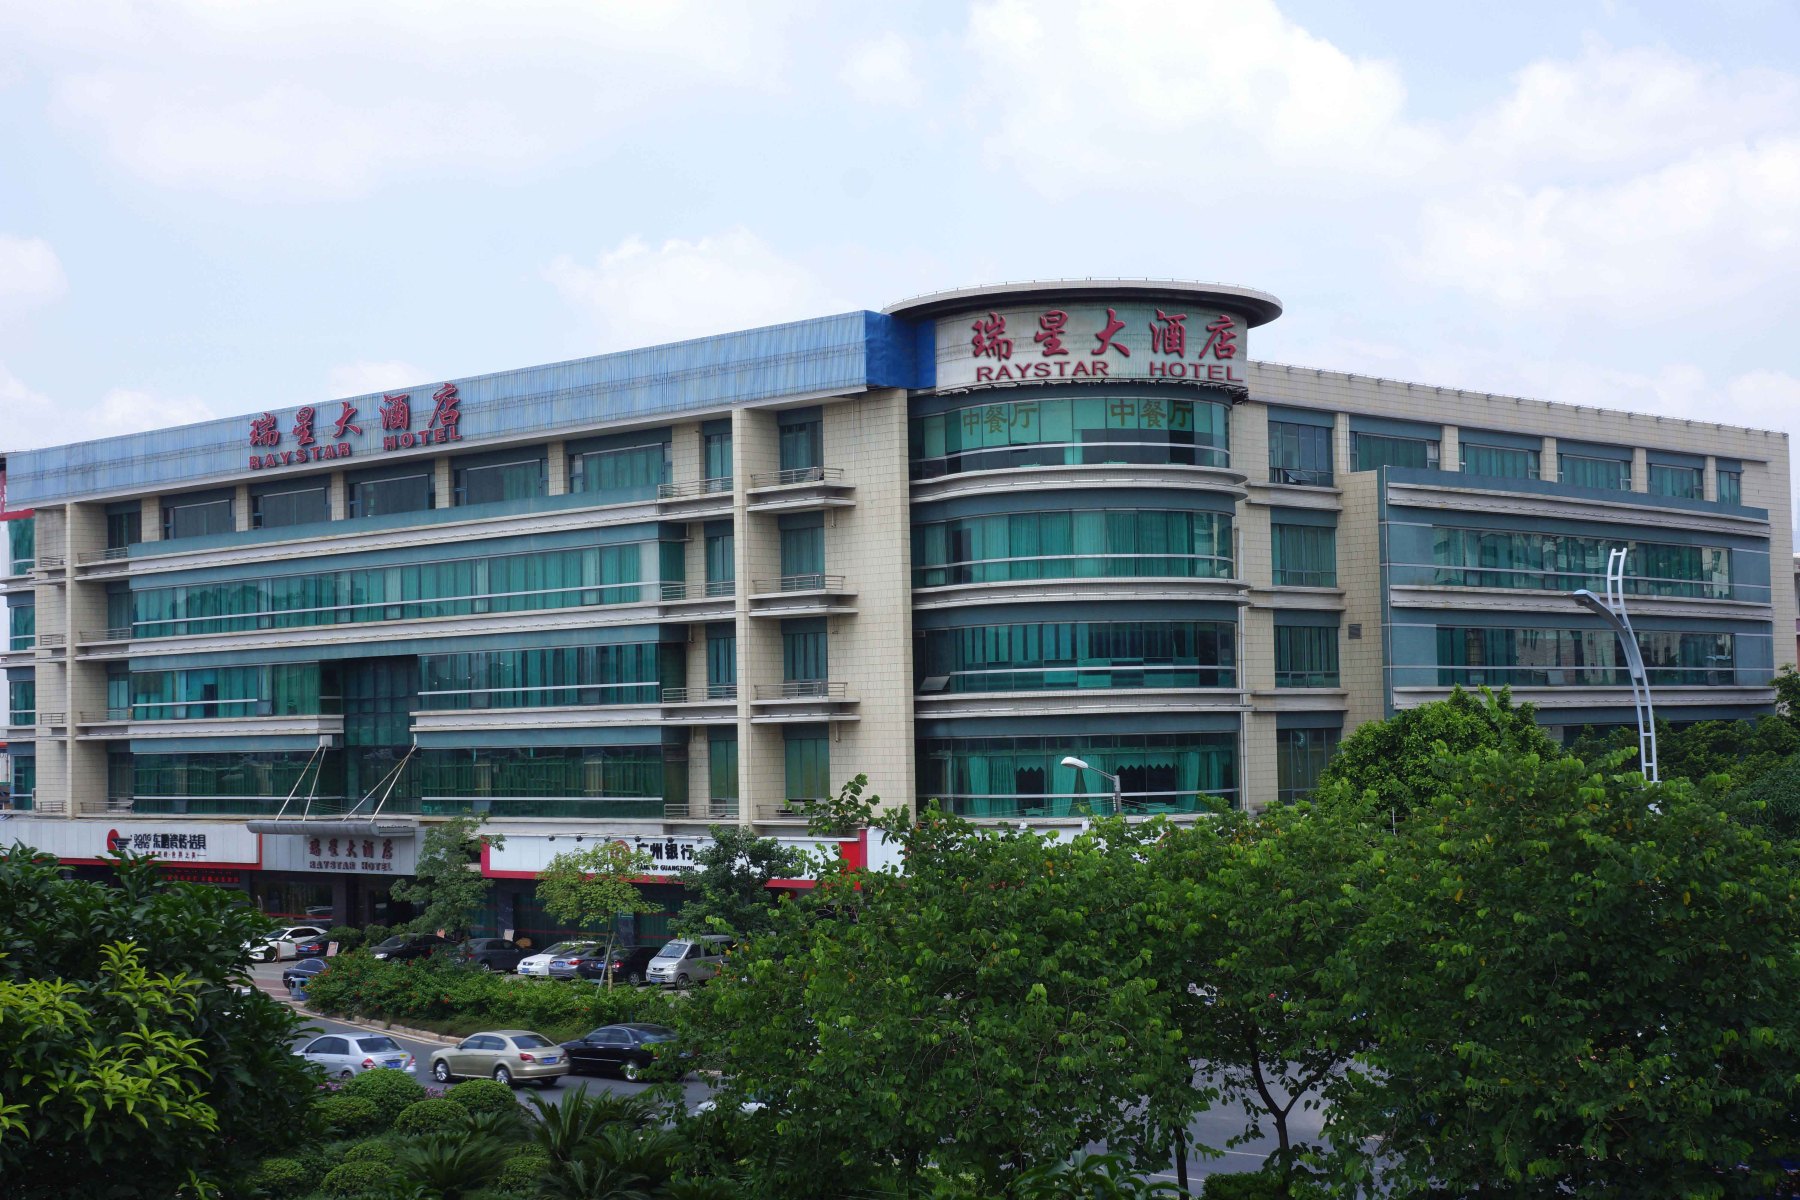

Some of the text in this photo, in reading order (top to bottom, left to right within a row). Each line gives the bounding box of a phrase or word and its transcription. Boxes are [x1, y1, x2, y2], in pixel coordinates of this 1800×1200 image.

[972, 308, 1238, 361] 瑞星大酒店
[976, 361, 1244, 383] RAYSTAR HOTEL
[249, 383, 461, 447] 瑞星大酒店
[962, 401, 1039, 437] 中餐厅
[1110, 398, 1193, 429] 中餐厅
[249, 425, 463, 470] RAYSTAR HOTEL
[309, 839, 393, 859] 瑞星大酒店
[637, 842, 694, 860] 广州银行
[309, 861, 393, 871] RAYSTAR HOTEL
[660, 864, 695, 872] GUANGZHOU
